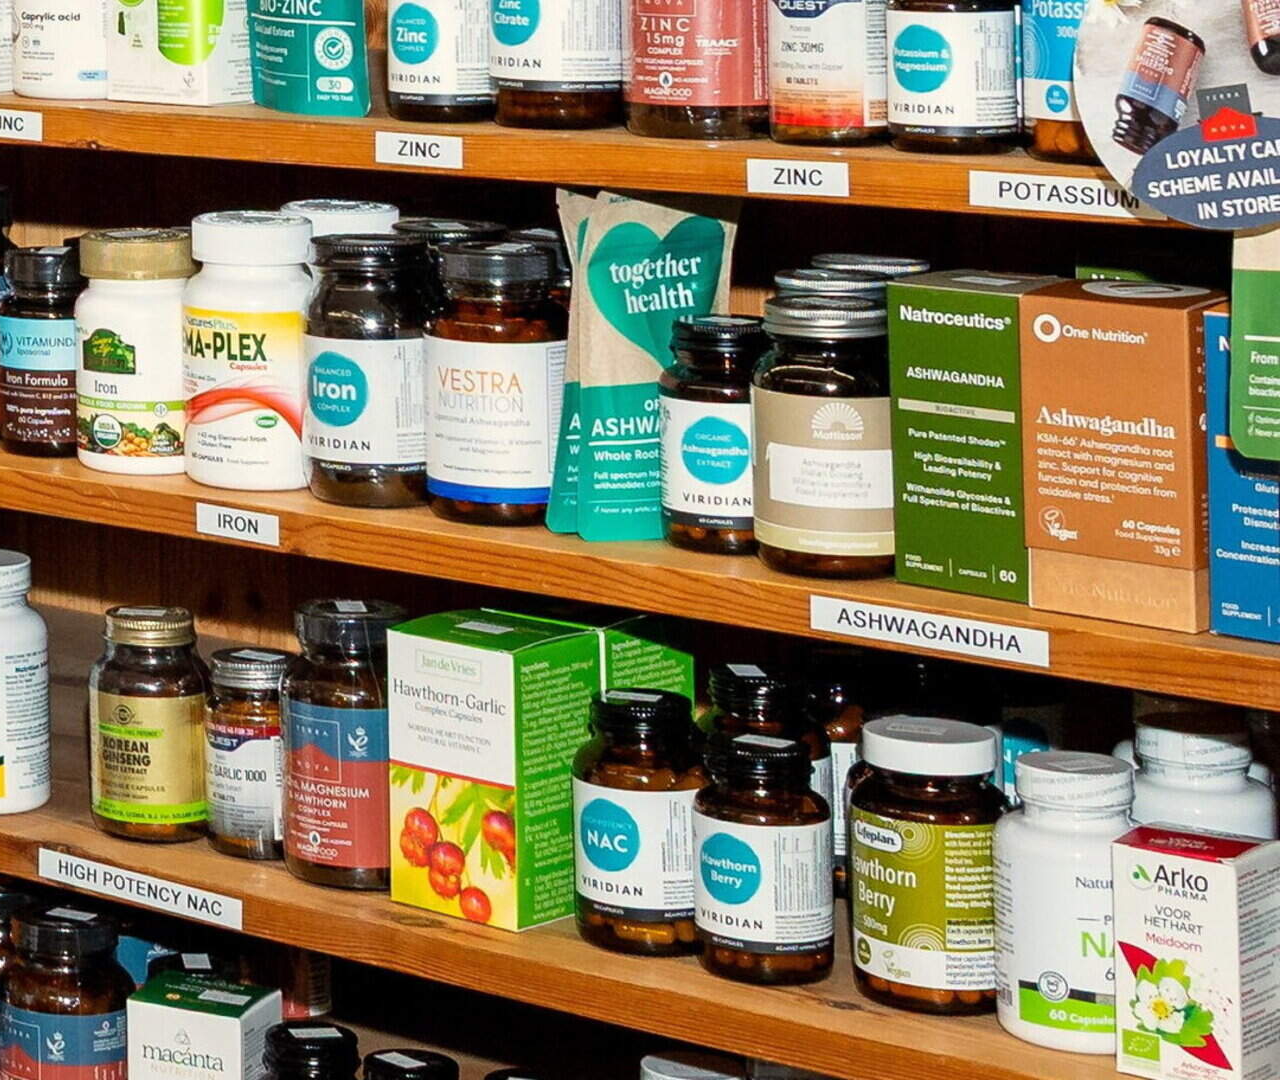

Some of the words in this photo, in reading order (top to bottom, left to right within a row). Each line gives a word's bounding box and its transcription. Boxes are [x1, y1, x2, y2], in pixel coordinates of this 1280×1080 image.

[778, 0, 827, 11] QUEST
[494, 12, 529, 27] Citrate
[640, 17, 690, 33] ZINC
[396, 27, 428, 43] Zinc
[645, 33, 685, 47] 15mg
[893, 103, 955, 116] VIRIDIAN
[398, 140, 441, 157] ZINC
[1165, 144, 1247, 169] LOYALTY
[773, 168, 823, 187] ZINC
[1148, 174, 1223, 197] SCHEME
[1227, 170, 1280, 190] AVAIL
[1198, 203, 1218, 220] IN
[609, 253, 702, 289] together
[1062, 324, 1089, 340] One
[1091, 327, 1148, 345] Nutrition
[5, 373, 23, 385] Iron
[25, 374, 68, 387] Formula
[437, 368, 523, 394] VESTRA
[906, 365, 1005, 389] ASHWAGANDHA
[94, 380, 118, 395] Iron
[311, 375, 357, 401] Iron
[437, 393, 524, 413] NUTRITION
[1036, 405, 1176, 441] Ashwagandha
[308, 435, 371, 452] VIRIDIAN
[594, 450, 632, 462] Whole
[634, 449, 659, 460] Root
[682, 492, 752, 506] VIRIDIAN
[216, 512, 259, 535] IRON
[837, 606, 1021, 654] ASHWAGANDHA
[392, 677, 507, 716] Hawthorn-Garlic
[103, 737, 150, 754] KOREAN
[300, 783, 370, 799] MAGNESIUM
[587, 828, 628, 854] NAC
[701, 851, 757, 874] Hawthorn
[58, 859, 98, 885] HIGH
[102, 869, 182, 914] POTENCY
[186, 892, 223, 917] NAC
[581, 876, 643, 897] VIRIDIAN
[710, 870, 744, 889] Berry
[1153, 864, 1209, 892] Arko
[858, 880, 896, 917] Berry
[1157, 887, 1209, 902] PHARMA
[1154, 905, 1191, 921] VOOR
[1145, 932, 1203, 953] Meidoorn
[141, 1044, 224, 1072] macánta
